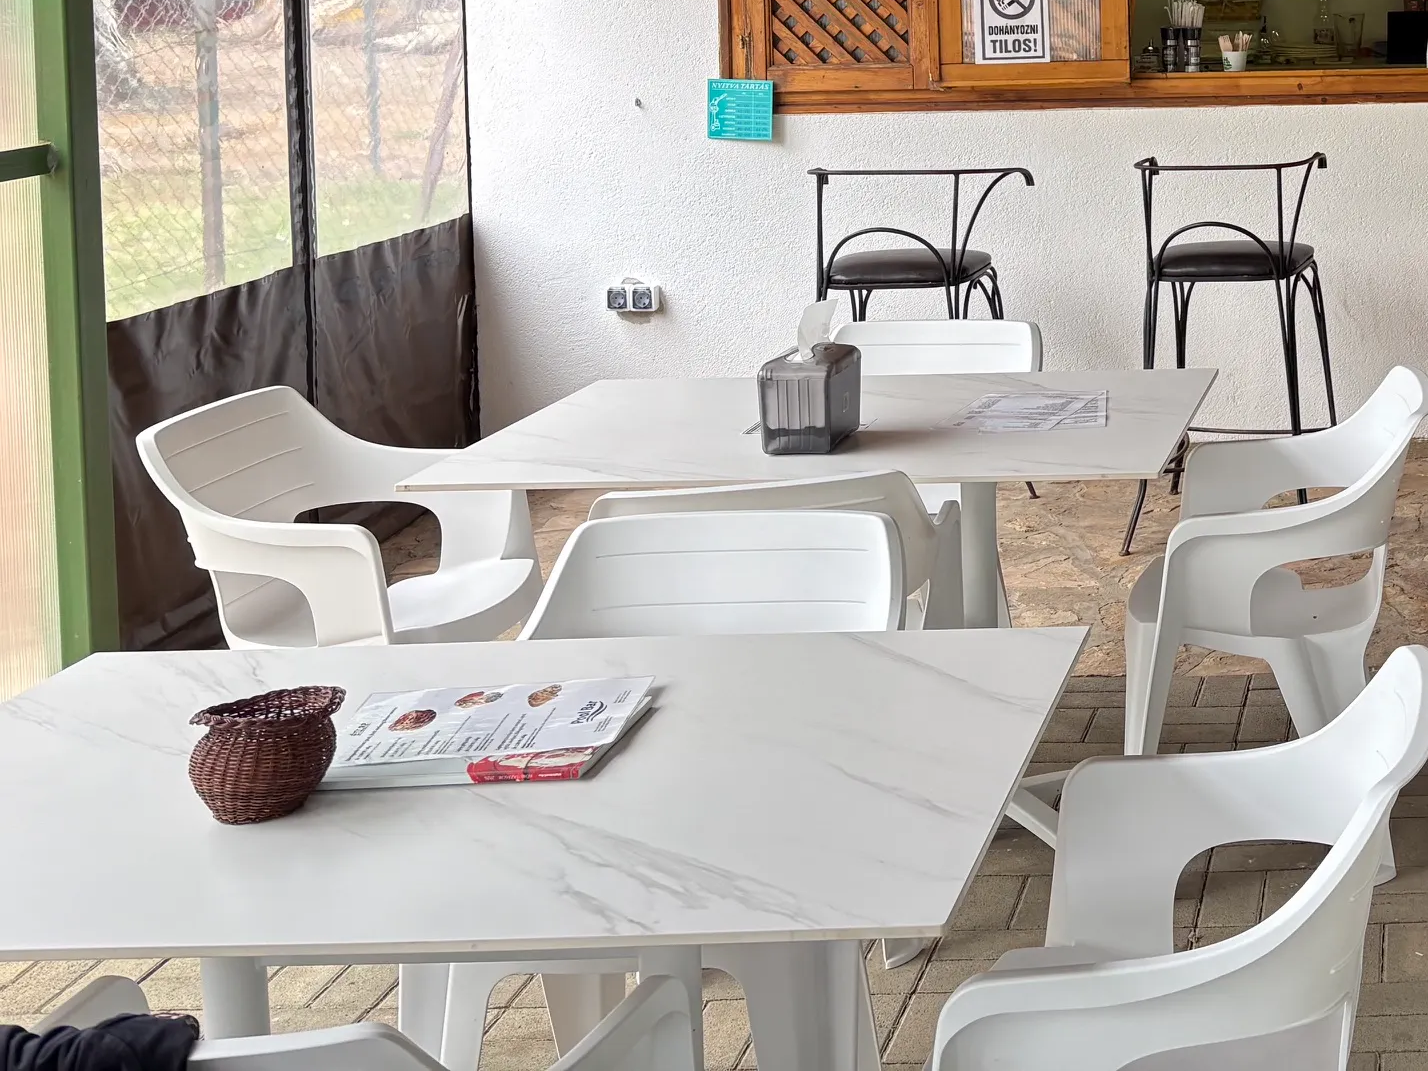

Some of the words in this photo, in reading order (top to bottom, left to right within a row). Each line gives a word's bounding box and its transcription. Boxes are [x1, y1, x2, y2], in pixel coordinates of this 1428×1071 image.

[988, 23, 1039, 35] DOHÁNYOZNI
[990, 38, 1038, 54] TILOS!
[740, 82, 769, 90] TARTÁS
[580, 700, 598, 711] Bar
[570, 710, 592, 725] Pool
